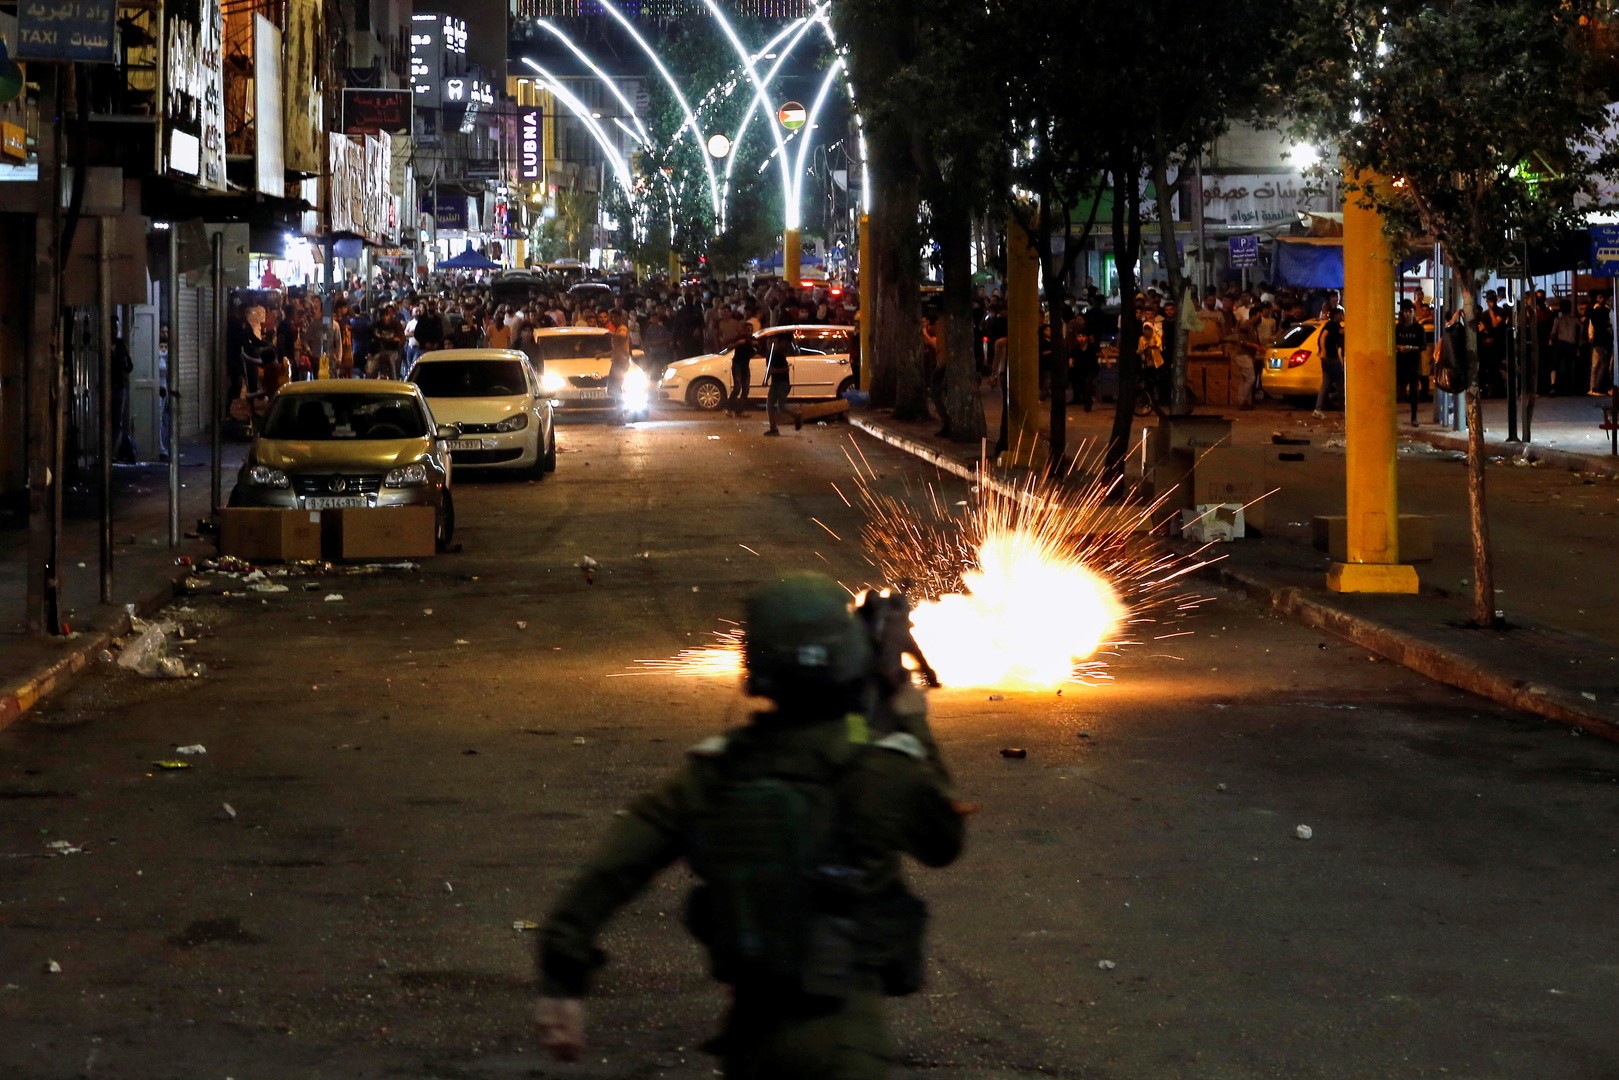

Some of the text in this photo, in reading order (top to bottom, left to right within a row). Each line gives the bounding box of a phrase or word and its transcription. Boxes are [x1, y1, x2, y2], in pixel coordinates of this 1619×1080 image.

[20, 29, 57, 44] TAXI
[523, 111, 537, 177] LUBNA
[1240, 238, 1247, 248] P
